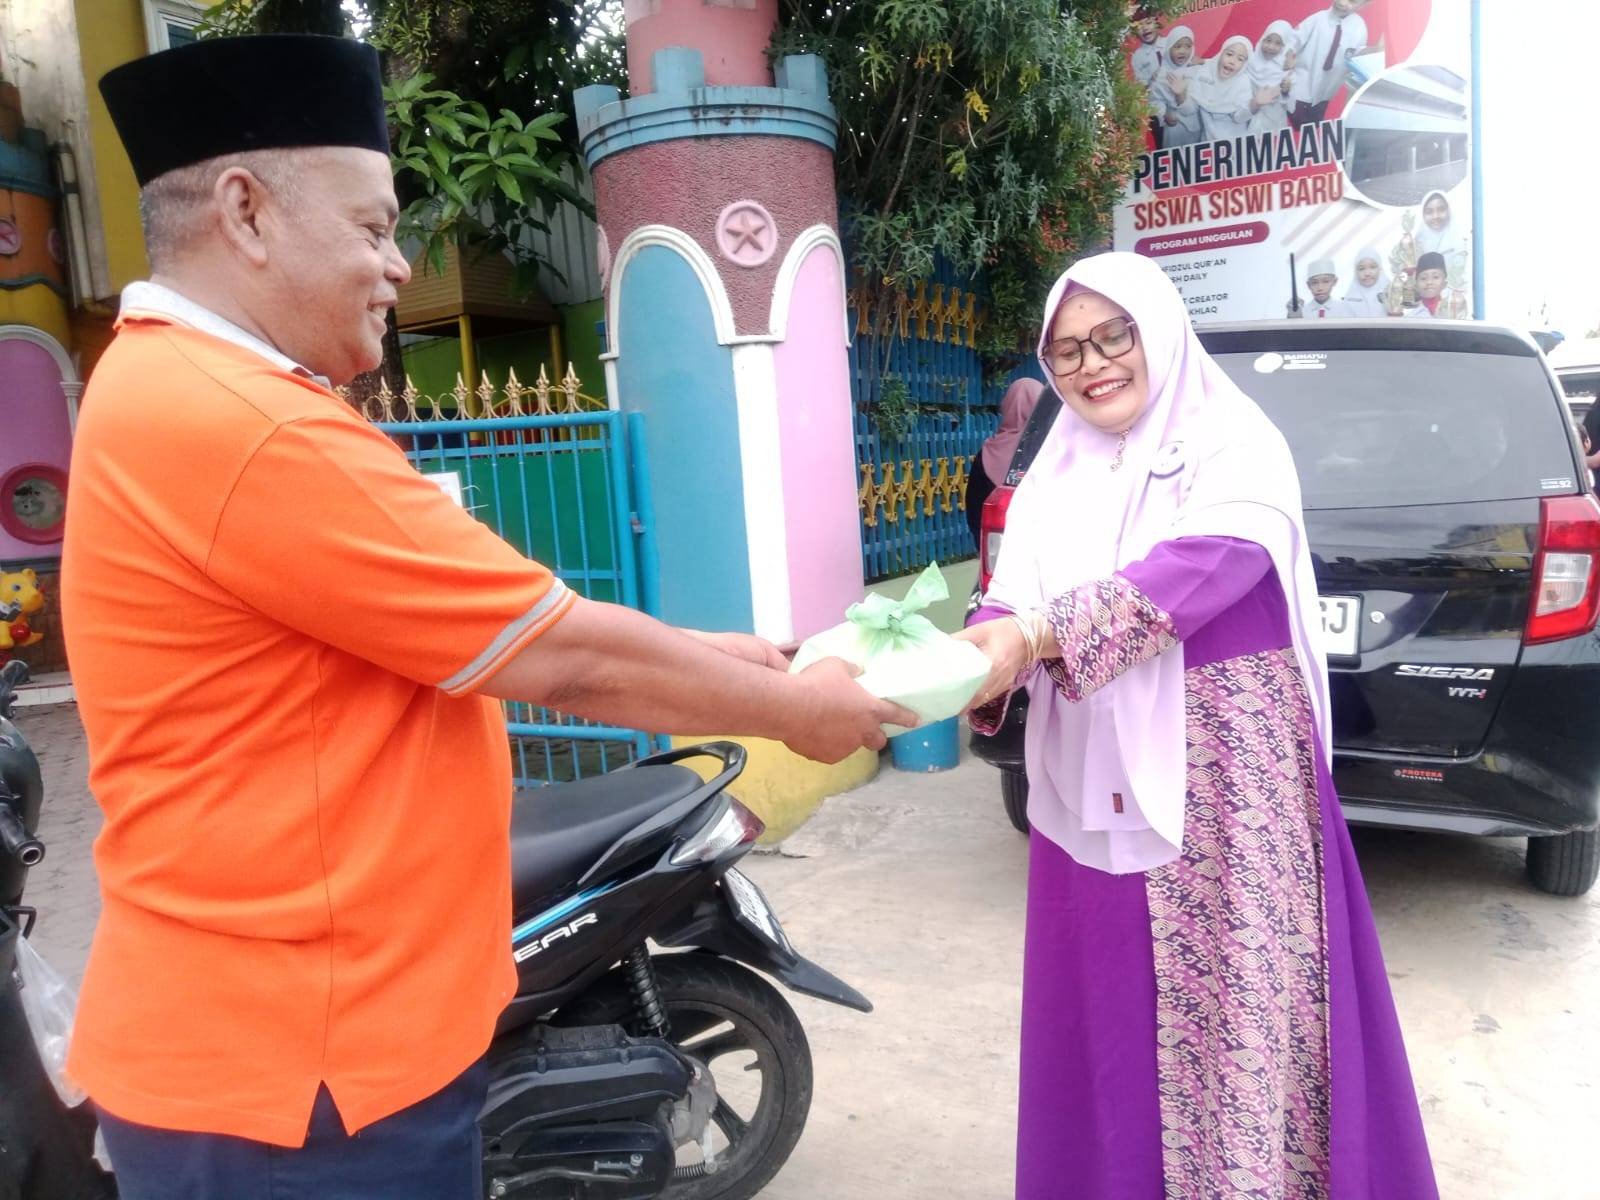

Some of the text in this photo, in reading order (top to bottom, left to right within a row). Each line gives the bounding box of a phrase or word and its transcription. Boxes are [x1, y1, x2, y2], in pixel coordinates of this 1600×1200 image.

[1134, 119, 1344, 193] PENERIMAAN
[1134, 171, 1344, 231] SISWA SISWI BARU
[1150, 229, 1253, 251] PROGRAM UNGGULAN
[1183, 273, 1208, 282] DAILY
[1189, 293, 1229, 304] CREATOR
[1189, 306, 1218, 316] KHLAQ
[1394, 664, 1495, 681] SIGRA
[513, 912, 599, 963] EAR
